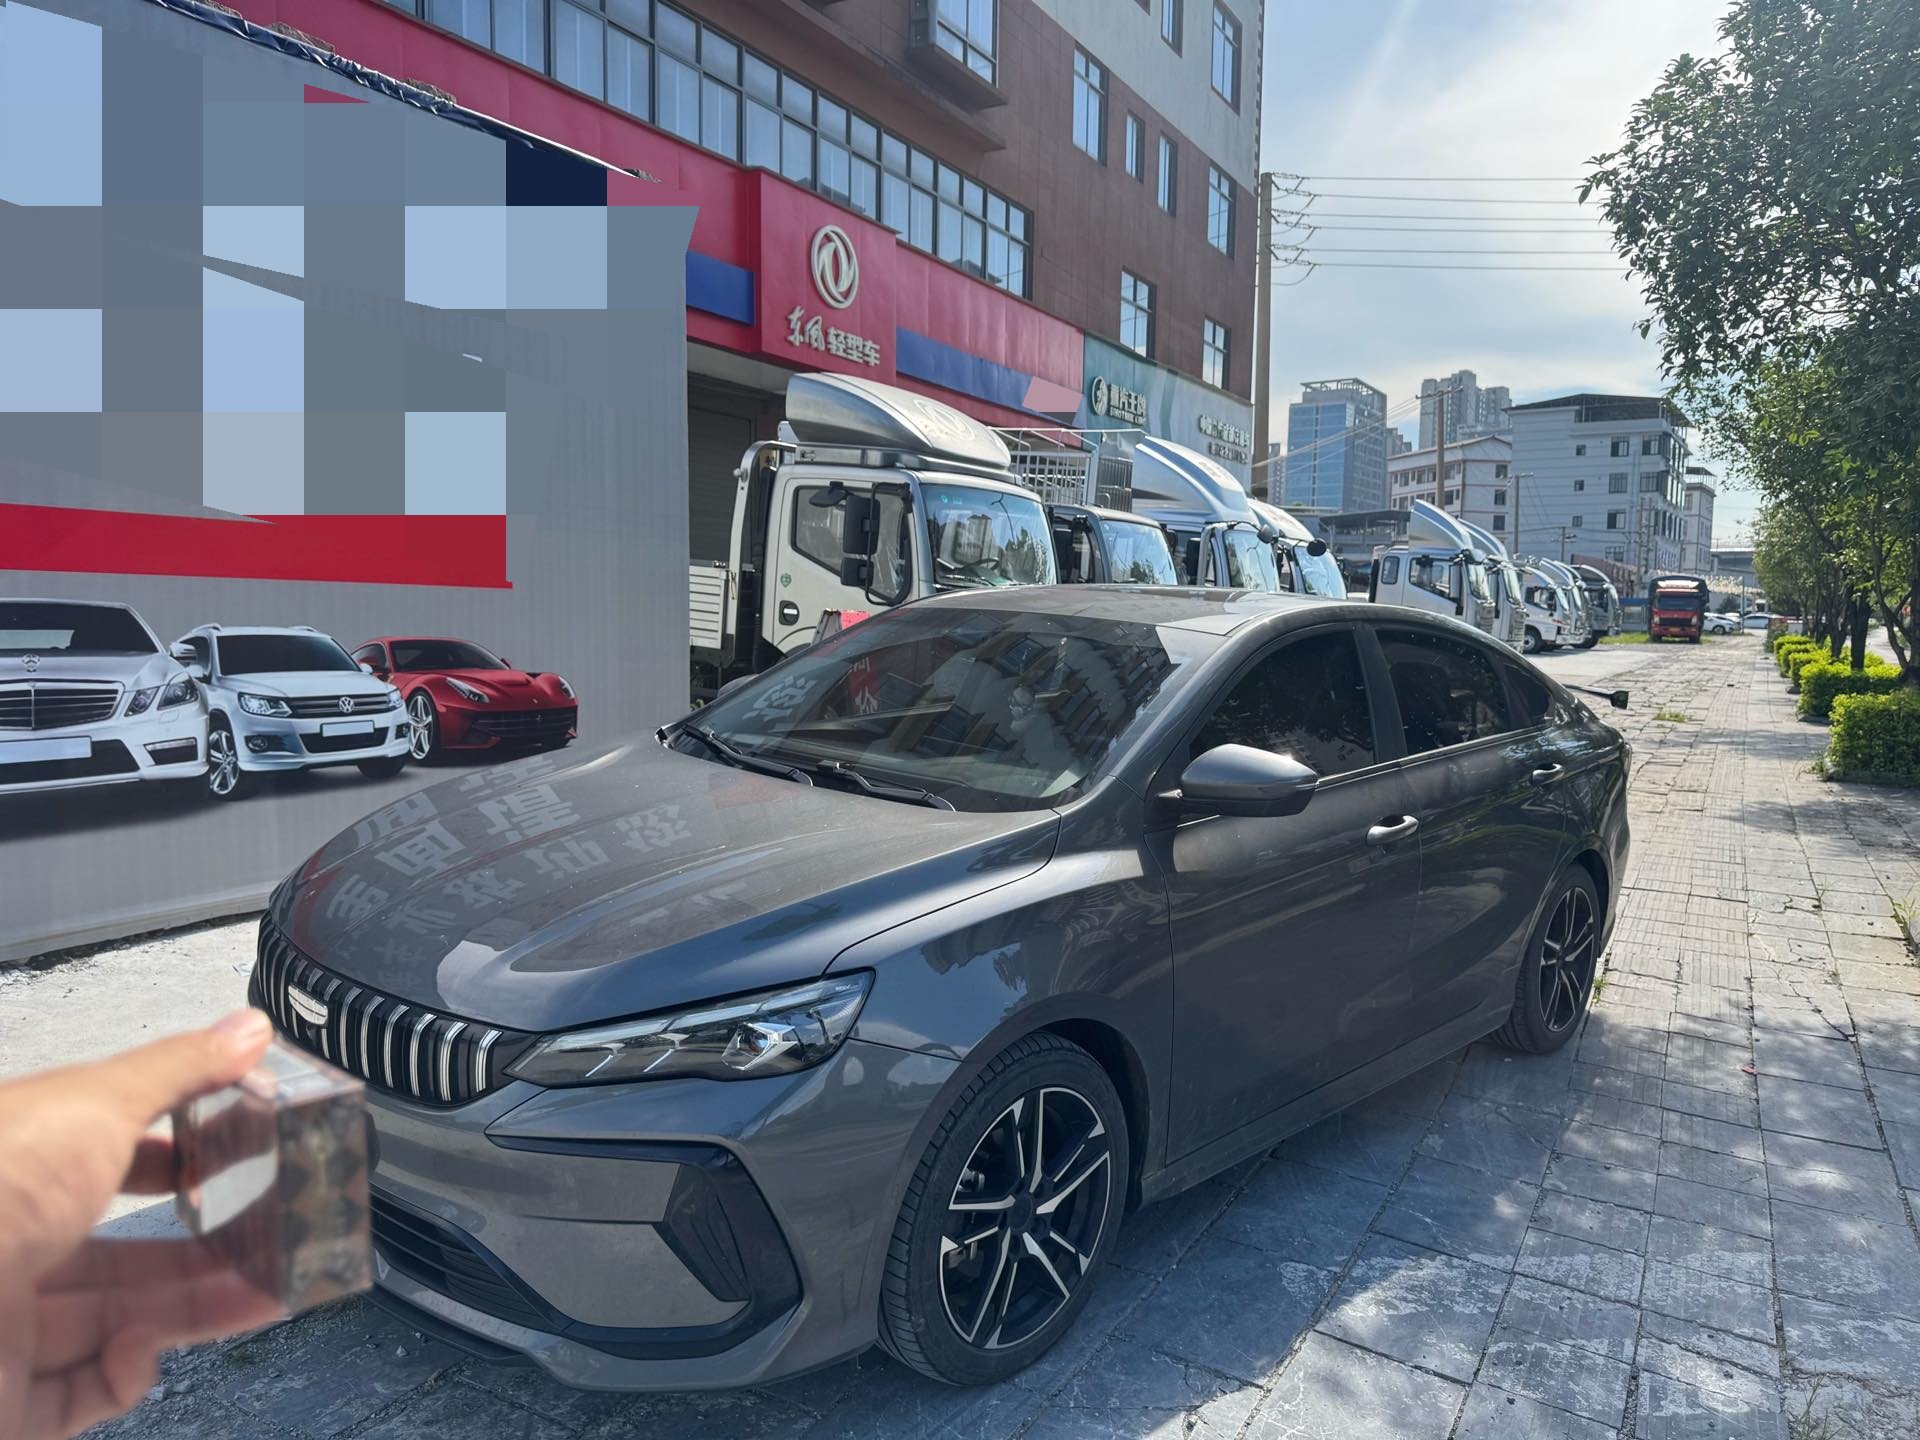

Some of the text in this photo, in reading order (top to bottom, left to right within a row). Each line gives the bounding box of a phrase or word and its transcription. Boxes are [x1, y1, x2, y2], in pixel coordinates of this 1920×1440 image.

[787, 305, 880, 367] 东风轻型车
